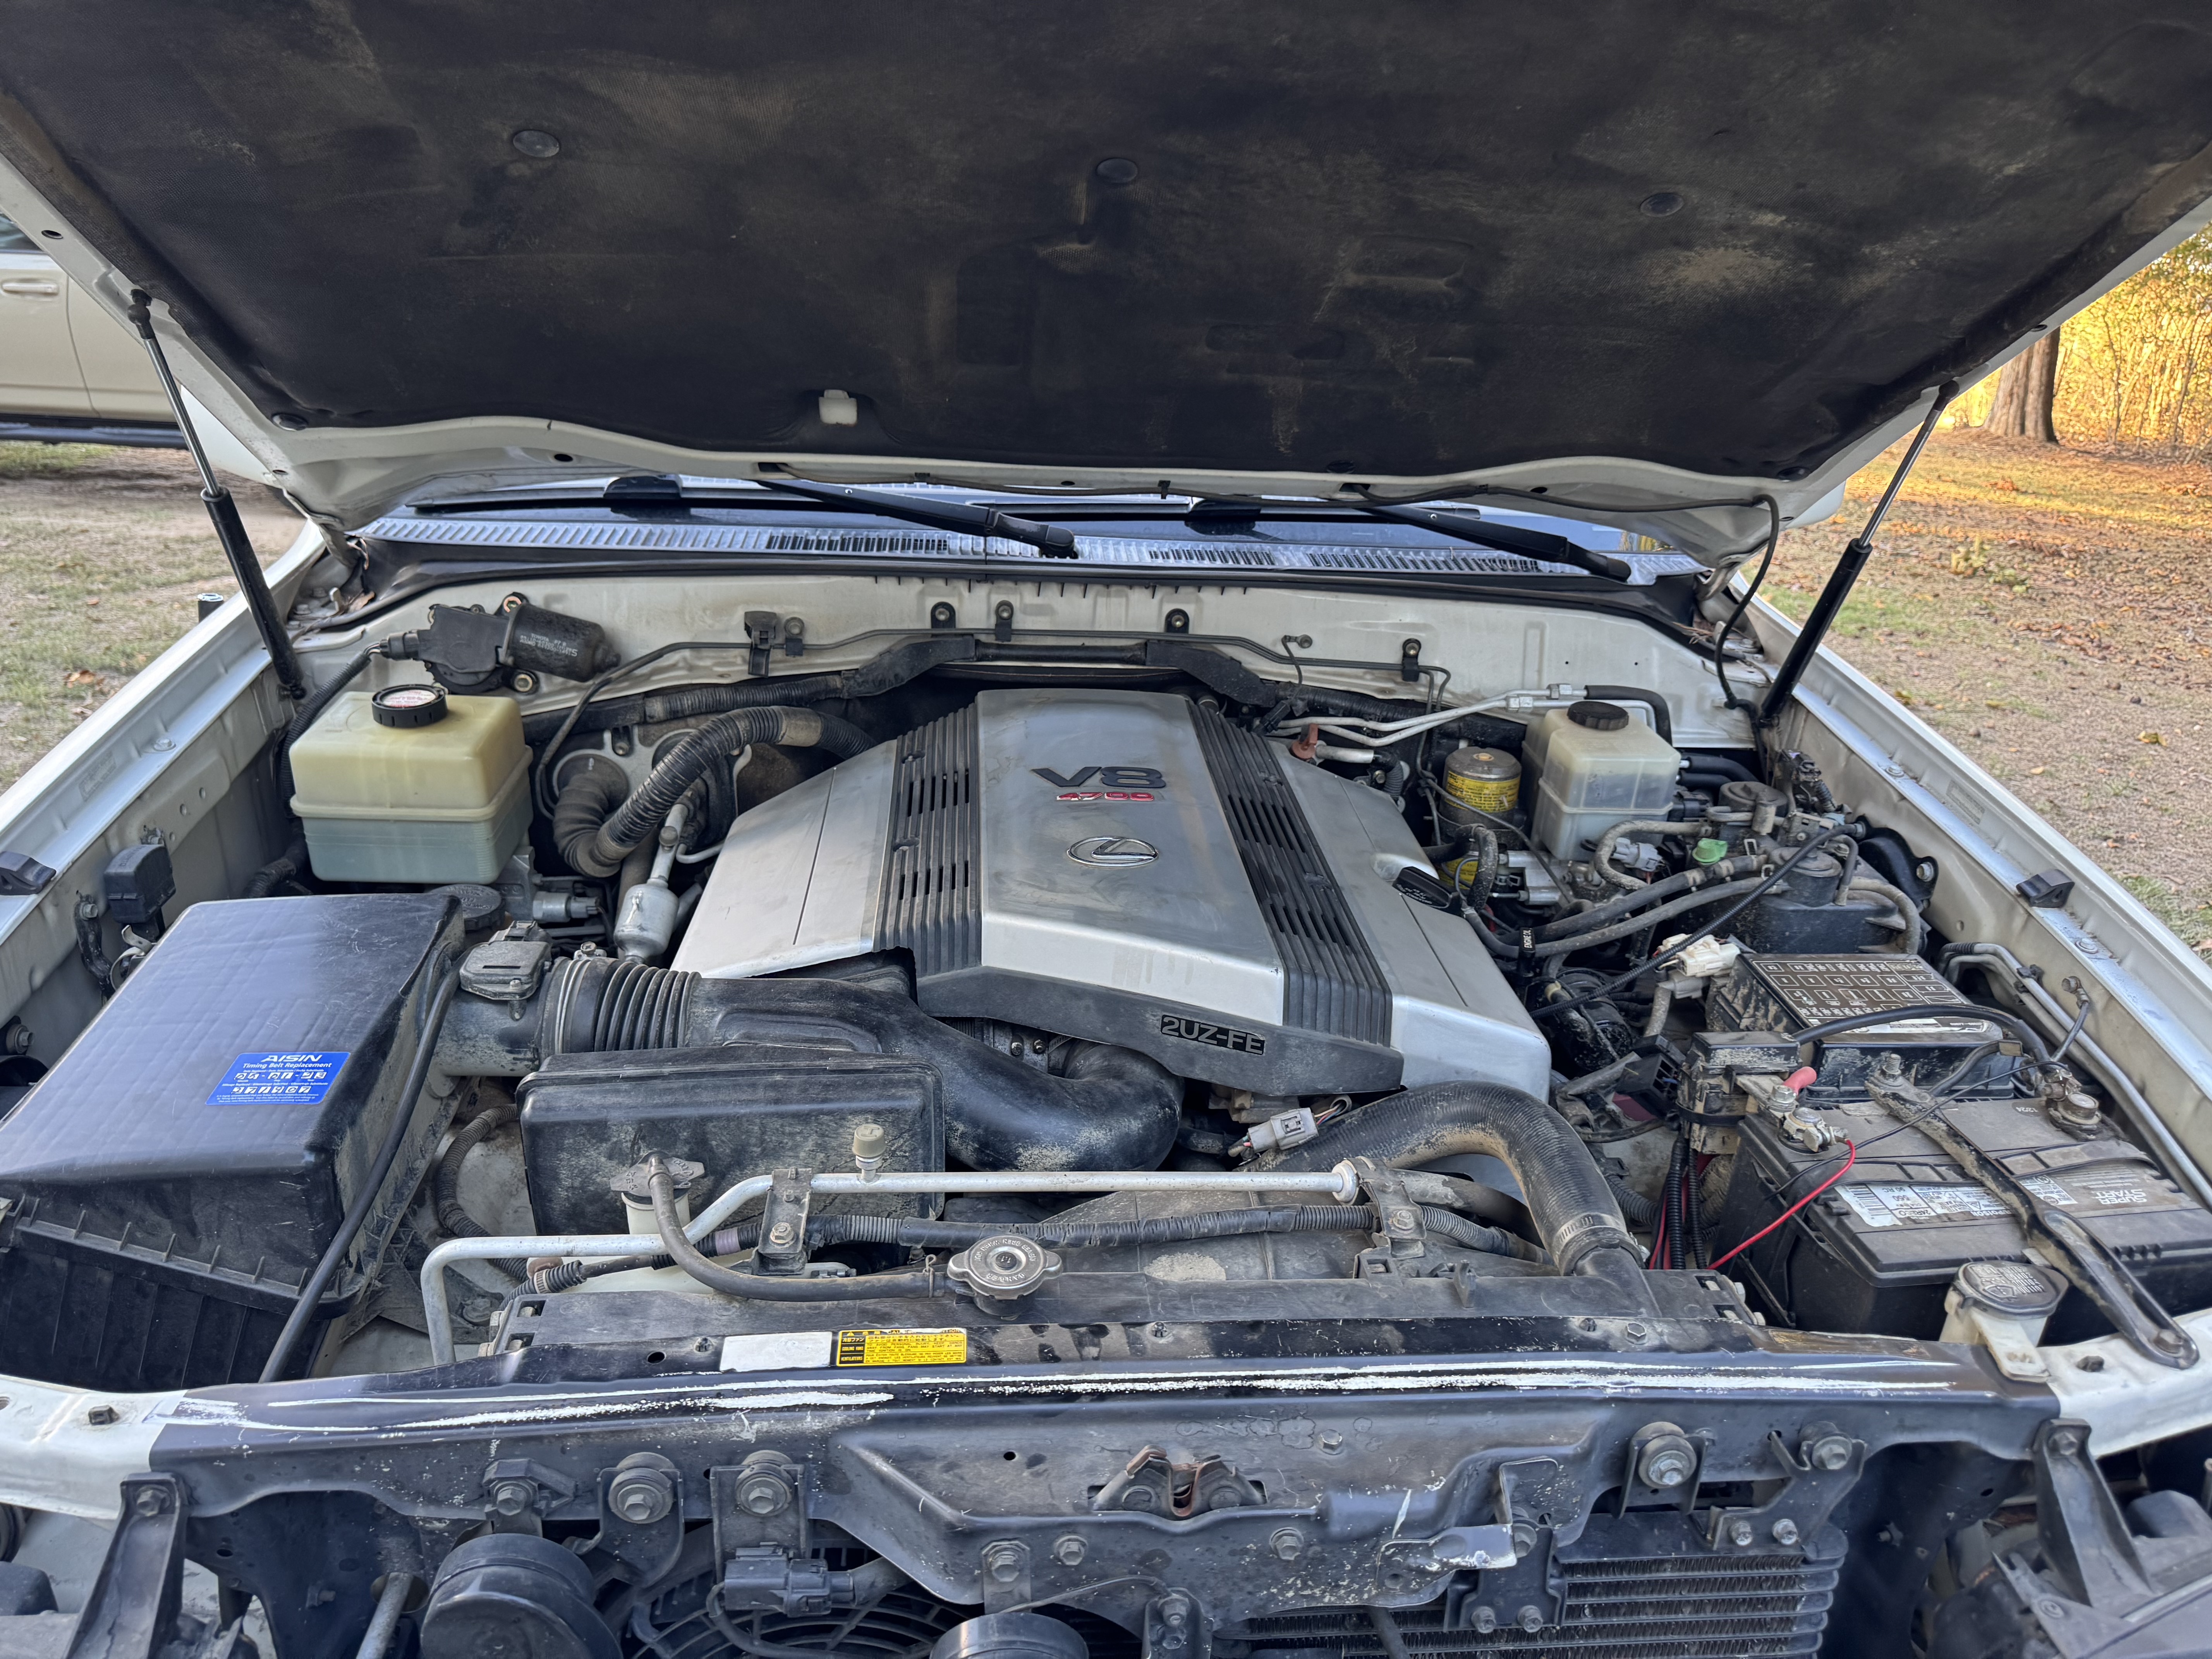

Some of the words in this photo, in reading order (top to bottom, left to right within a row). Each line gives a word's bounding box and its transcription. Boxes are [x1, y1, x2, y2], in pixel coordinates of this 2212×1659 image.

[1031, 766, 1166, 788] V8
[1056, 792, 1154, 801] 4700
[1163, 1017, 1263, 1054] 2UZ-FE
[2093, 1189, 2147, 1199] START
[2098, 1195, 2147, 1205] SUPER
[1002, 1238, 1021, 1247] OPEN
[1021, 1244, 1037, 1261] NEVER
[1001, 1255, 1012, 1264] 1.1
[986, 1273, 1025, 1282] DANGER
